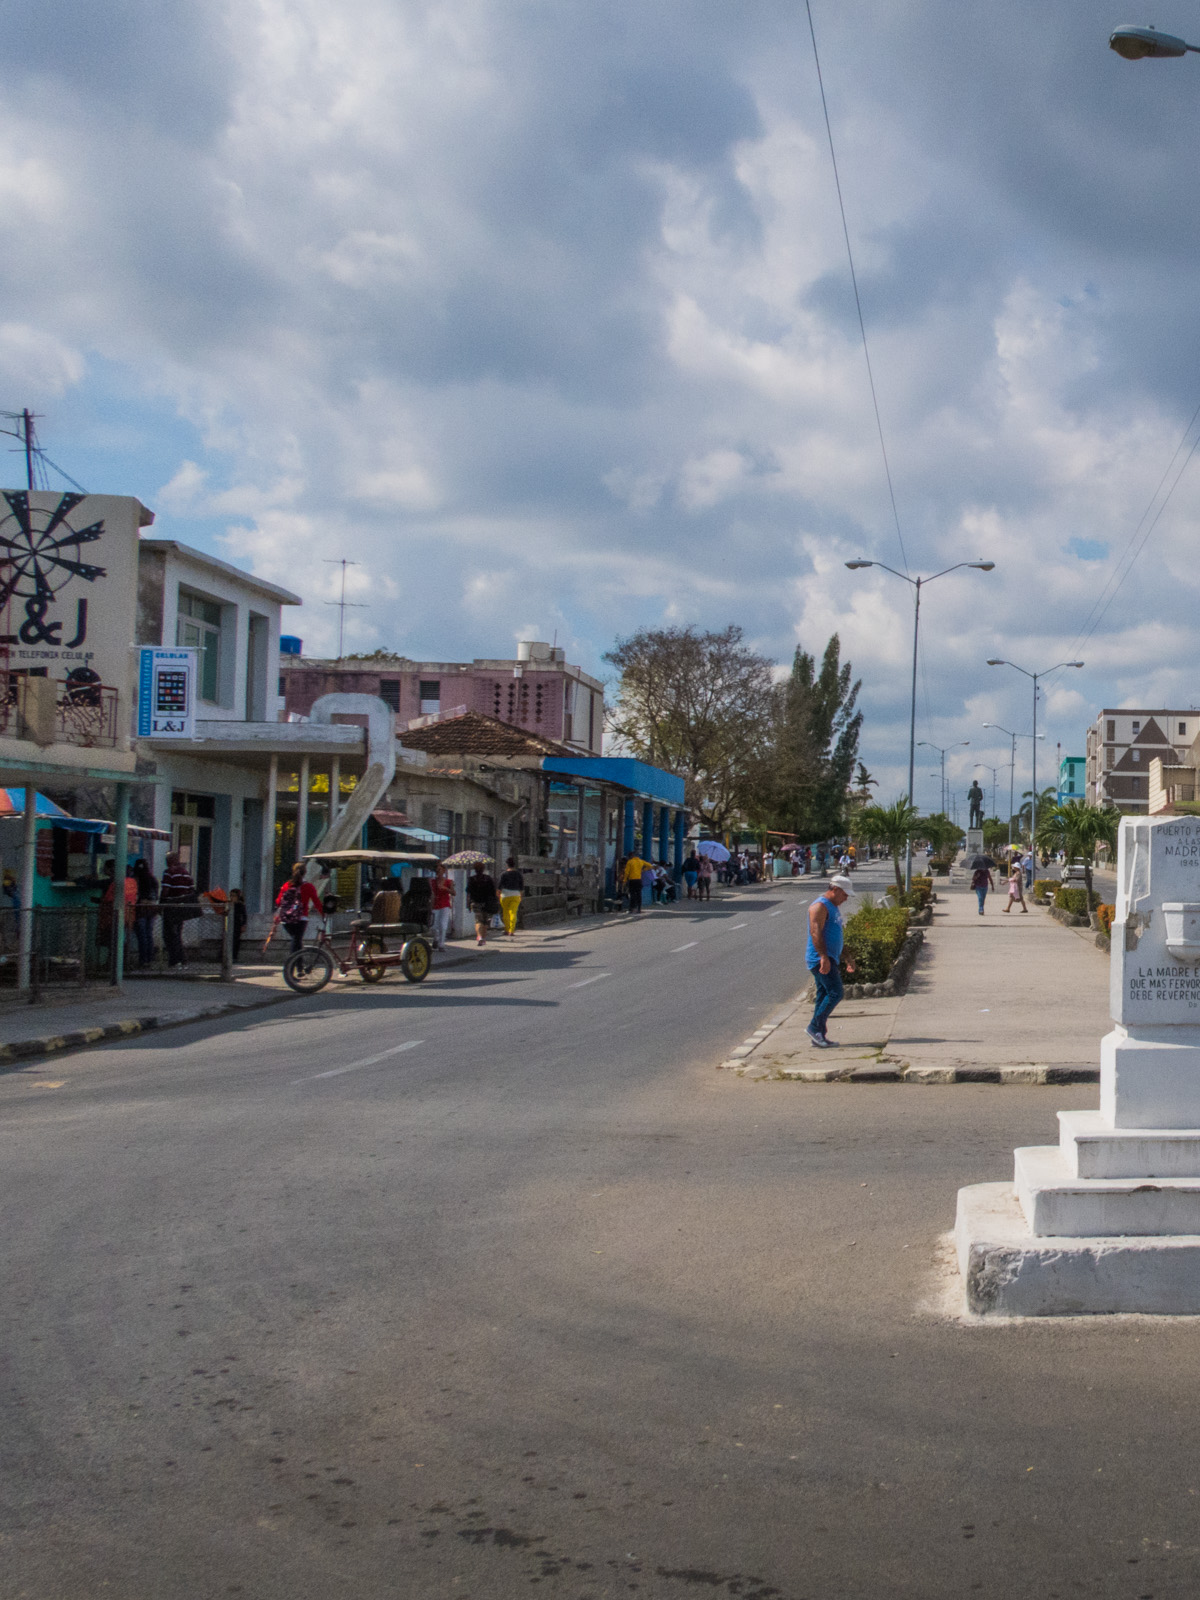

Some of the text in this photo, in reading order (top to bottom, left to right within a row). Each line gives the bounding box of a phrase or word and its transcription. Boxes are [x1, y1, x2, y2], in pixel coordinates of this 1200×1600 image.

[61, 651, 94, 660] CELULAR
[153, 720, 185, 732] L&J
[1157, 825, 1191, 836] PUERTO
[1139, 967, 1153, 978] LA
[1156, 967, 1190, 978] MADRE
[1130, 979, 1146, 989] QUE
[1149, 979, 1166, 989] MAS
[1130, 990, 1153, 1001] DEBE
